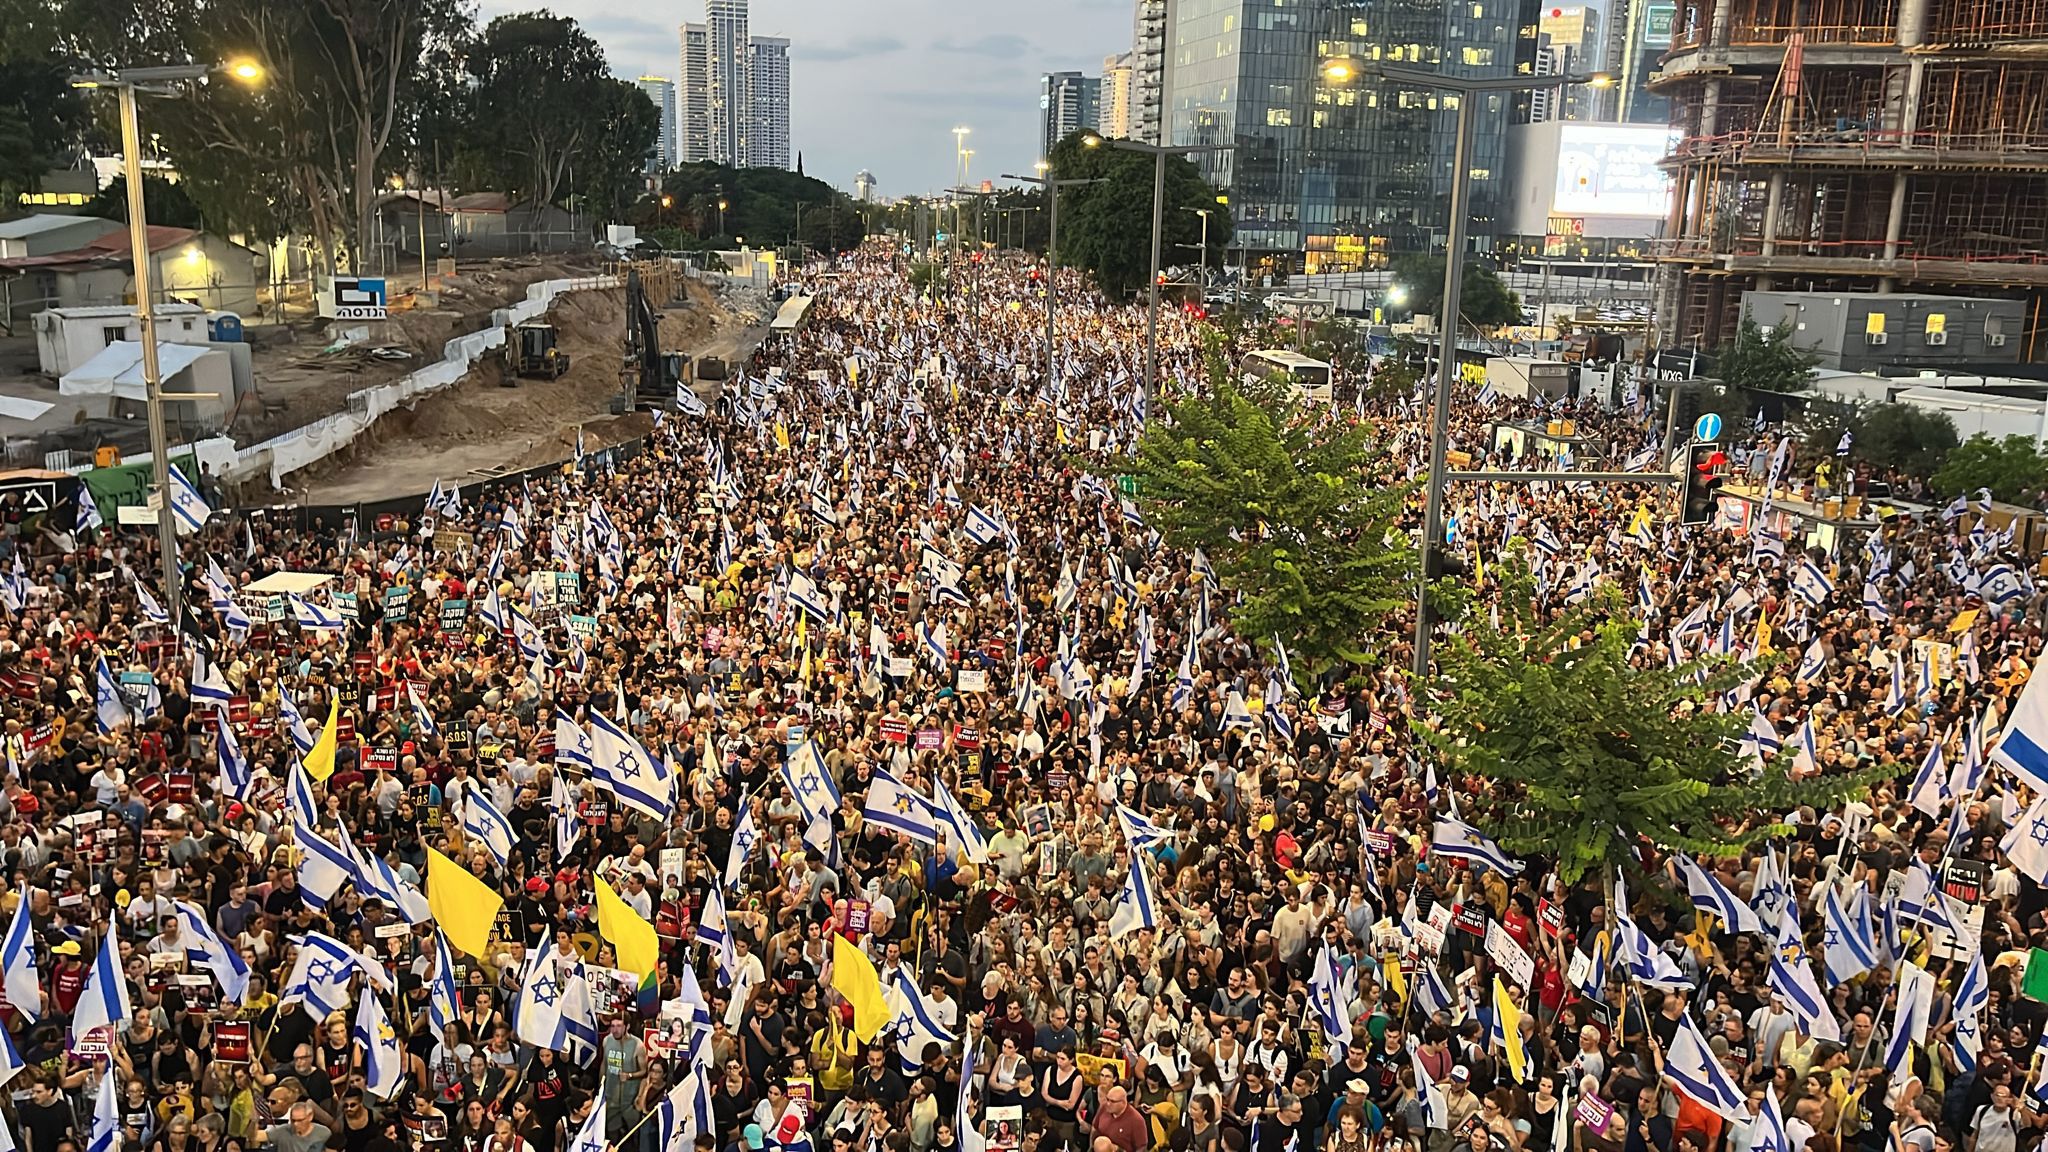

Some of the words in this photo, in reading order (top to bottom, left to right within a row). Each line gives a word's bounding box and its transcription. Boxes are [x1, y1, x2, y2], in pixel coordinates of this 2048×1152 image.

[1661, 369, 1683, 382] WXG
[559, 578, 577, 587] SEAL
[561, 586, 576, 595] THE
[559, 594, 579, 603] DEAL
[572, 621, 593, 632] SEAL
[340, 691, 358, 701] S.O.S
[448, 731, 466, 743] S.O.S
[1946, 883, 1977, 901] NOW
